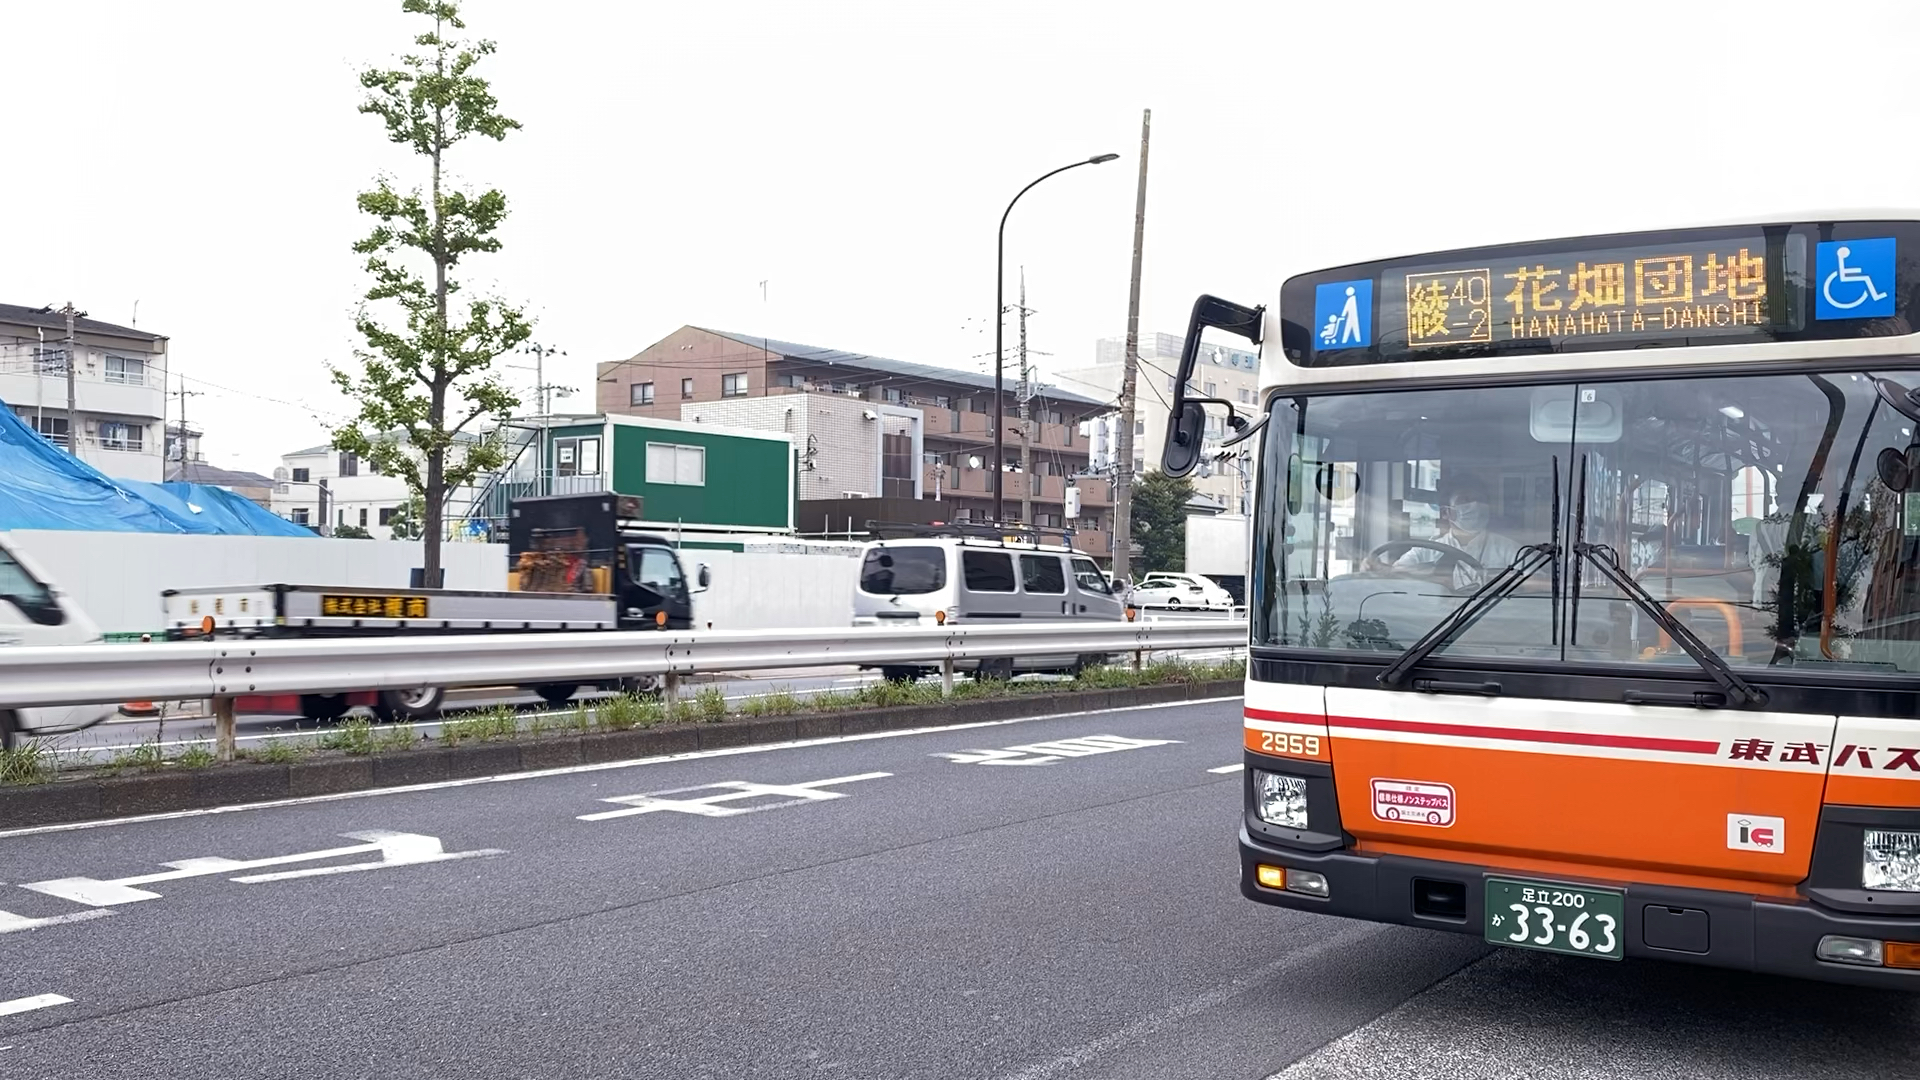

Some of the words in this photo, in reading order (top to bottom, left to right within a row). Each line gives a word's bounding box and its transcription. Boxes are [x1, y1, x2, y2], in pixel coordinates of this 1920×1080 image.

[1450, 277, 1486, 306] 40
[1504, 249, 1767, 314] 花畑団地
[1511, 301, 1762, 339] HANAHATA-DANCHI
[1261, 732, 1320, 756] 2959
[1728, 738, 1920, 772] 東武バス
[1522, 888, 1585, 908] 足立200
[1491, 913, 1505, 927] か
[1509, 904, 1616, 953] 33-63
